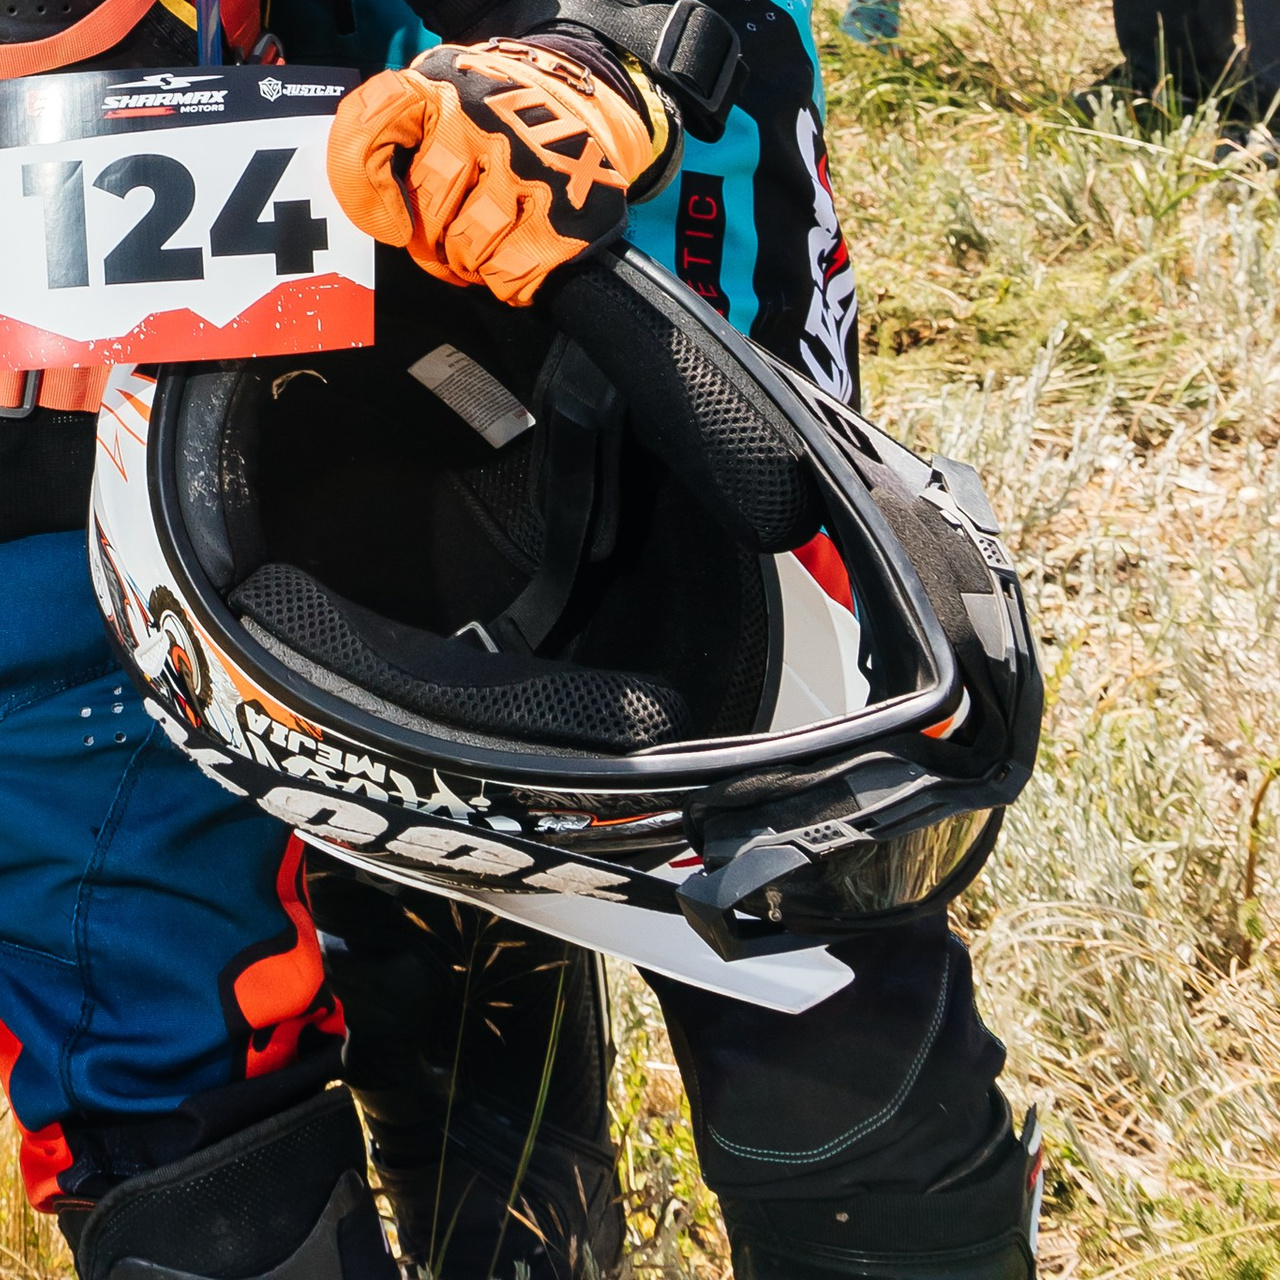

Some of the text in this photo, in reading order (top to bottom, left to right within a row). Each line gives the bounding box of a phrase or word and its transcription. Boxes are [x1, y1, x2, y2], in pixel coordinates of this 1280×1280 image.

[101, 90, 229, 110] SHARMAX
[282, 83, 345, 97] JUSTCAT
[179, 103, 225, 114] MOTORS
[21, 148, 329, 289] 124
[244, 701, 388, 783] MEJIA
